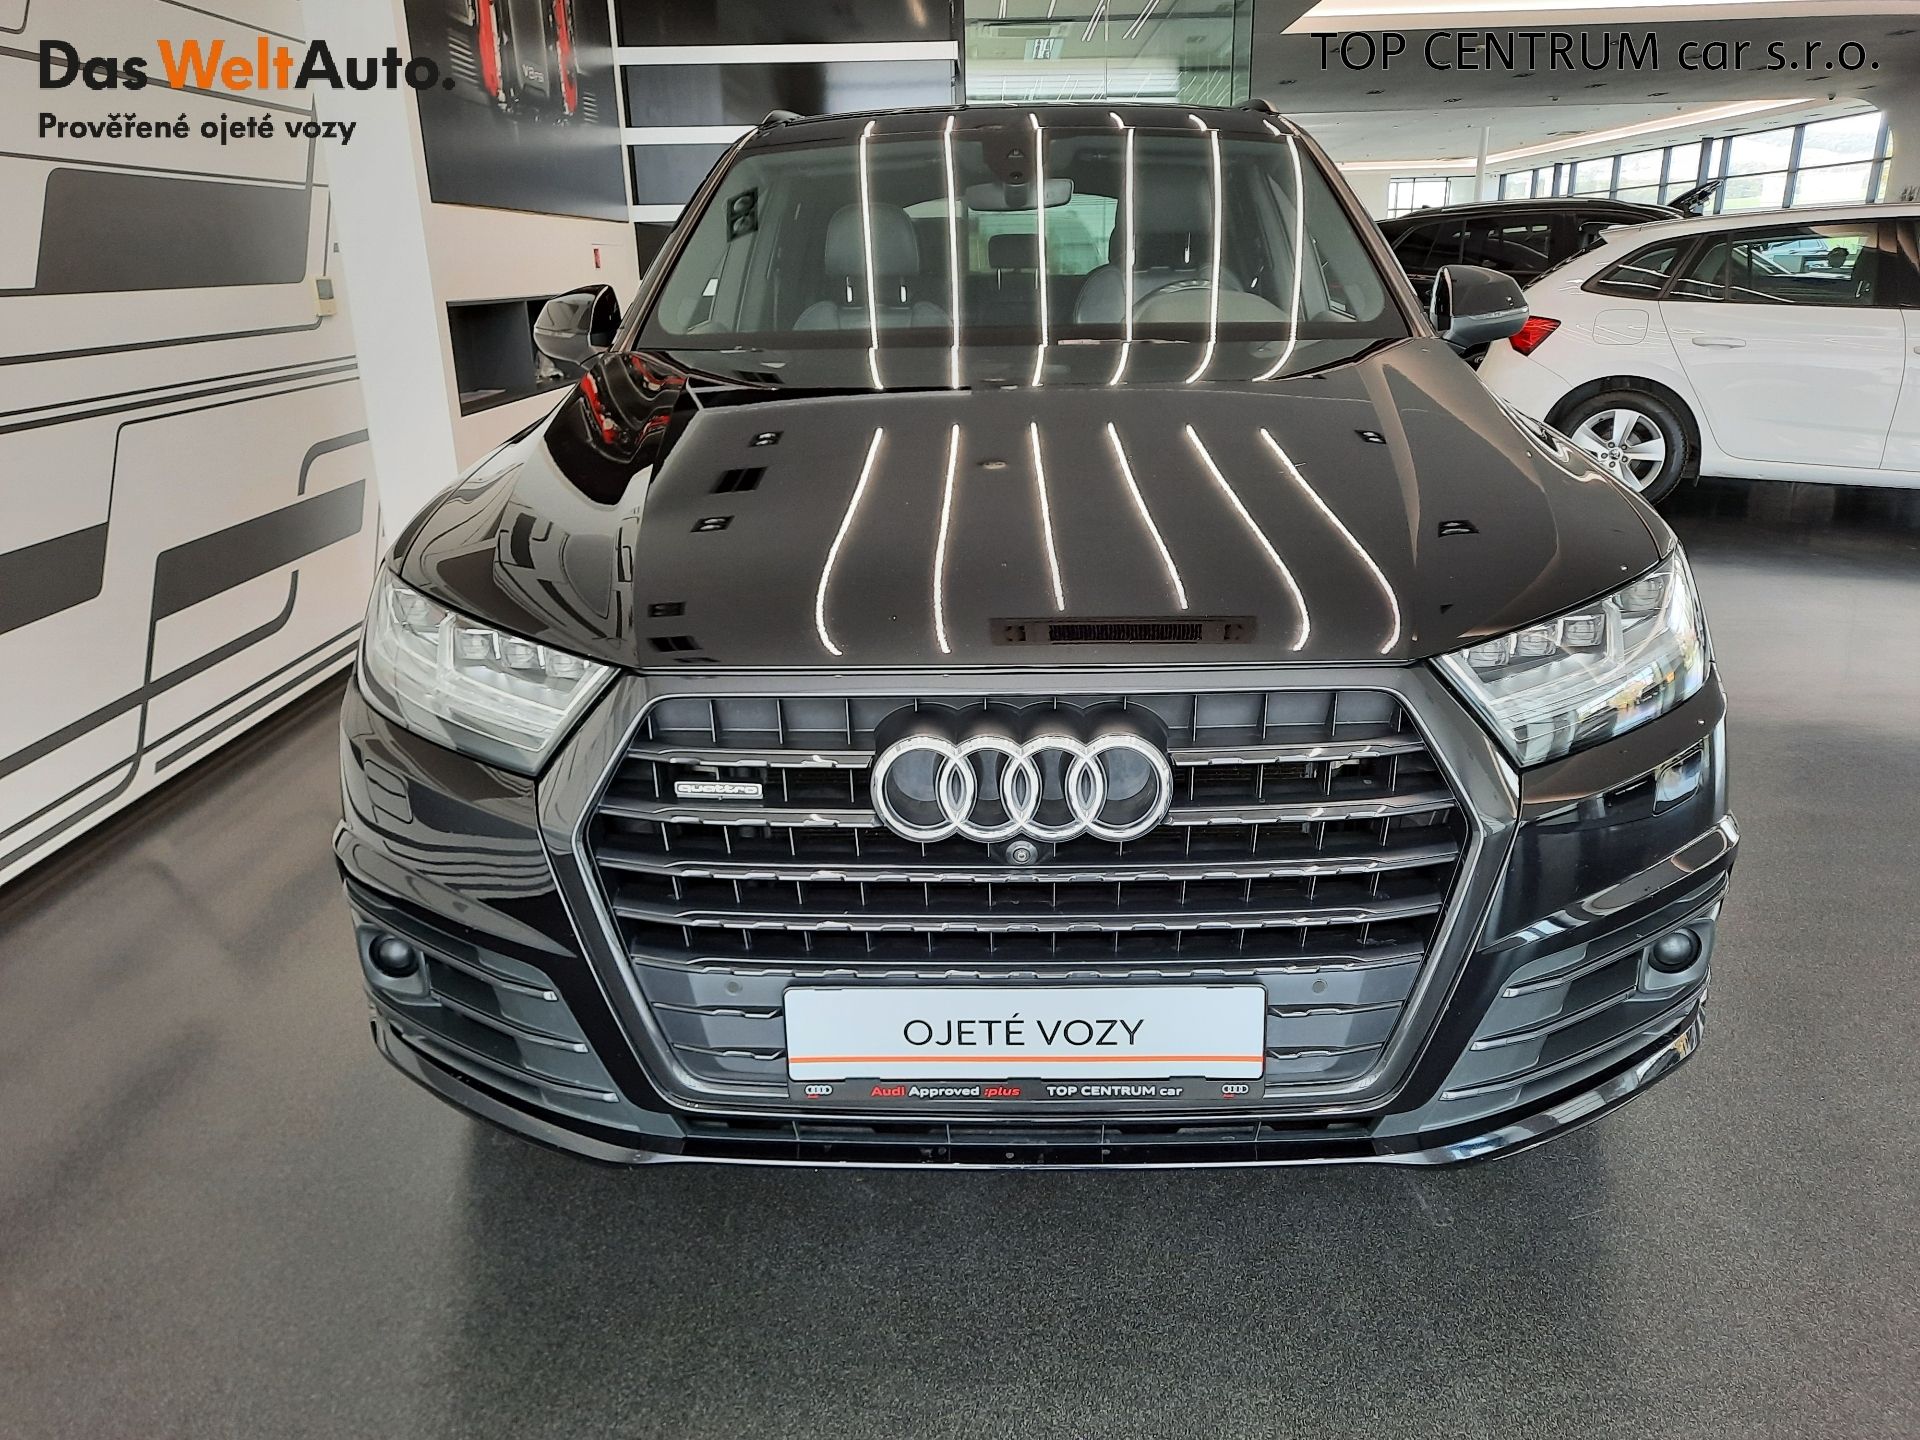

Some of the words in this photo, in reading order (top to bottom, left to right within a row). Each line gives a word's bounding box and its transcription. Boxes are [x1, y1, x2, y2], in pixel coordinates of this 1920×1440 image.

[677, 784, 758, 794] quattro
[903, 1013, 1025, 1046] OJETÉ
[1036, 1019, 1144, 1045] VOZY
[871, 1086, 905, 1096] Audi
[908, 1086, 980, 1099] Approved
[1047, 1086, 1078, 1096] TOP
[1081, 1086, 1155, 1097] CENTRUM
[1159, 1087, 1183, 1096] car
